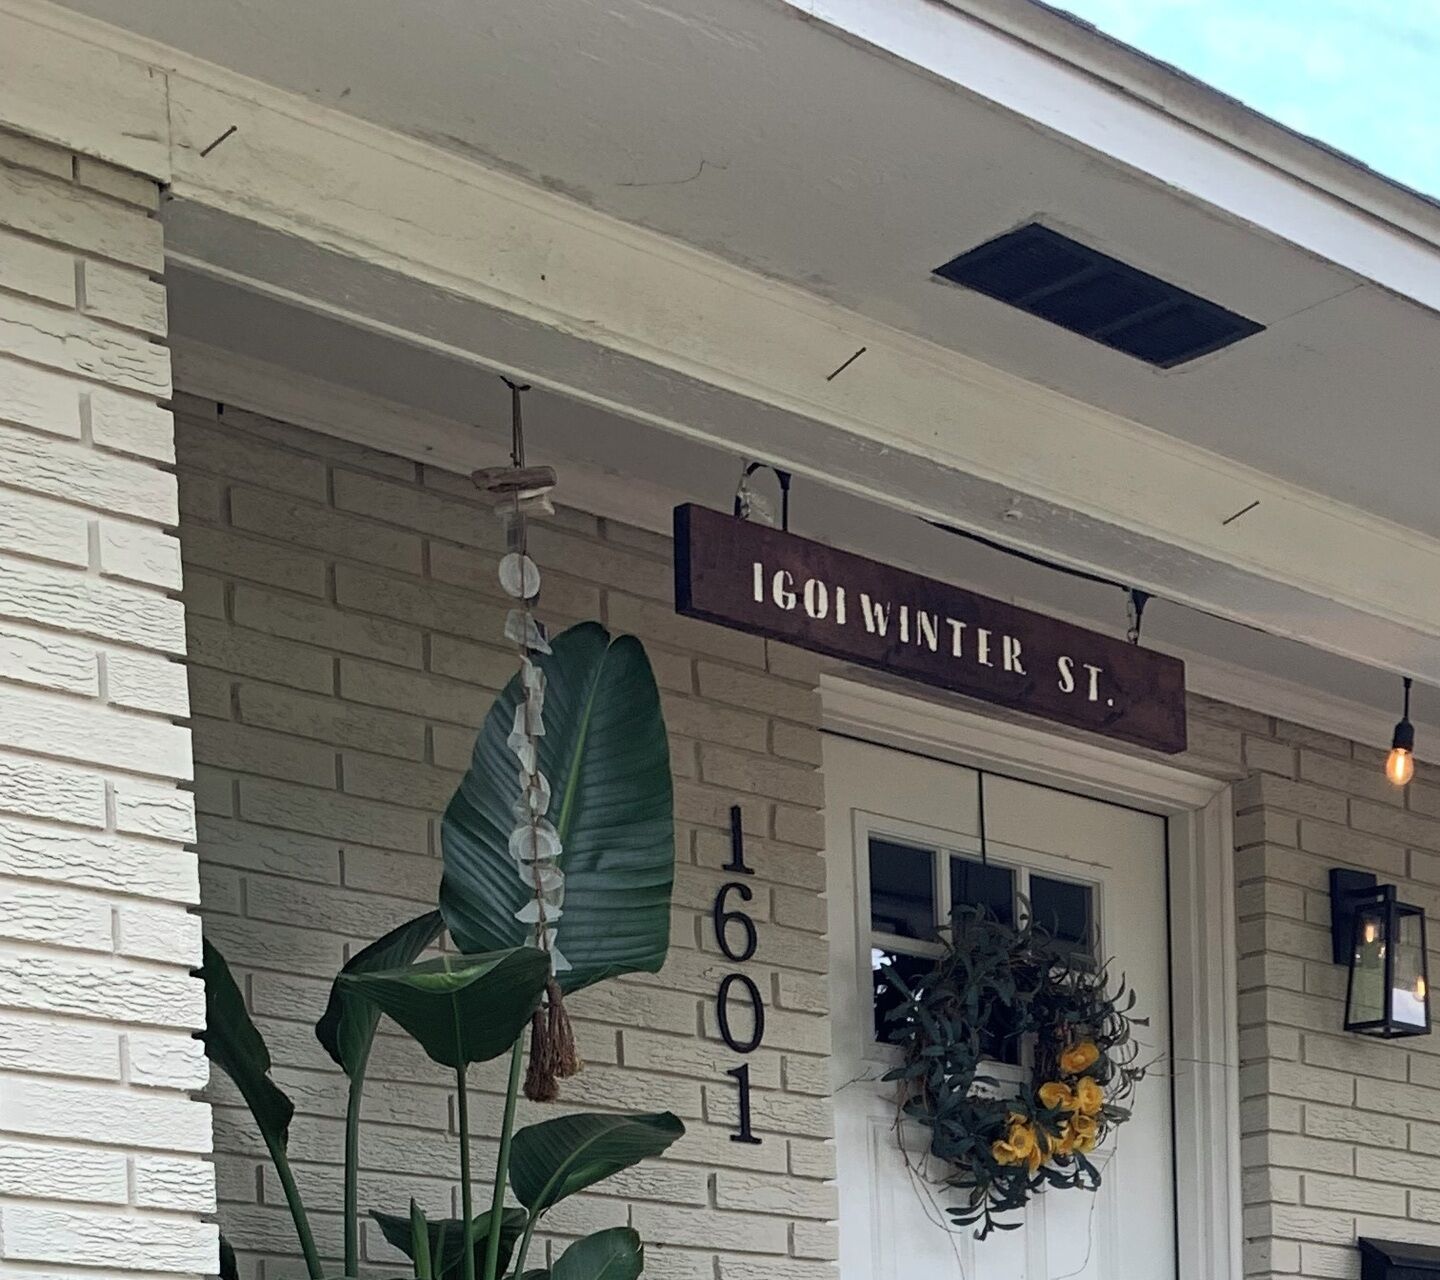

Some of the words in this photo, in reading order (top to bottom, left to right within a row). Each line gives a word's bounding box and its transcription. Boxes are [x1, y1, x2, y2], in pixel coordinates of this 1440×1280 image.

[860, 593, 1027, 675] WINTER
[1058, 656, 1115, 706] ST.
[714, 804, 765, 1145] 1601
